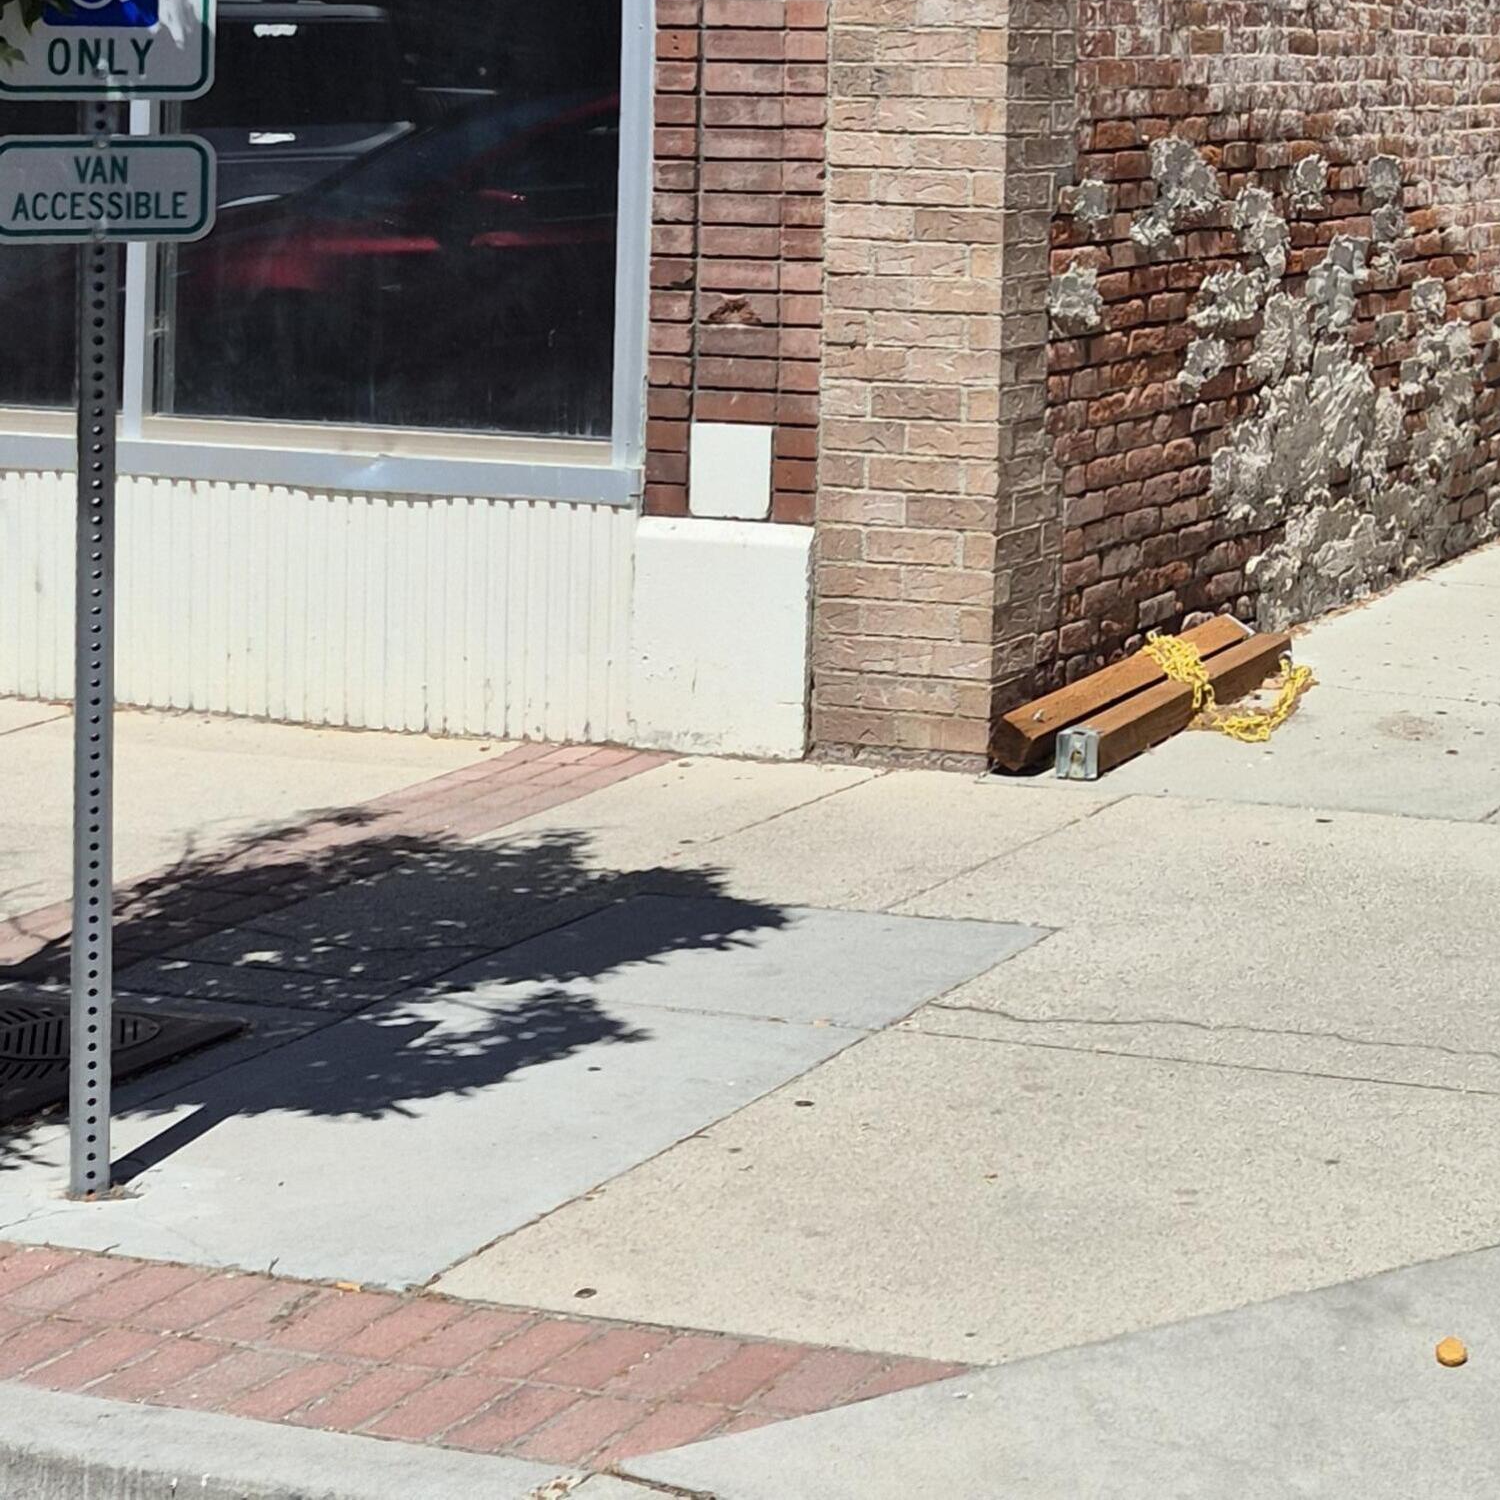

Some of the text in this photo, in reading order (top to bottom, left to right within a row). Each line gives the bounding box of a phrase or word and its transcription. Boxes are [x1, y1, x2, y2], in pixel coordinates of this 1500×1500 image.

[47, 37, 154, 76] ONLY
[73, 155, 129, 184] VAN
[11, 191, 188, 221] ACCESSIBLE
